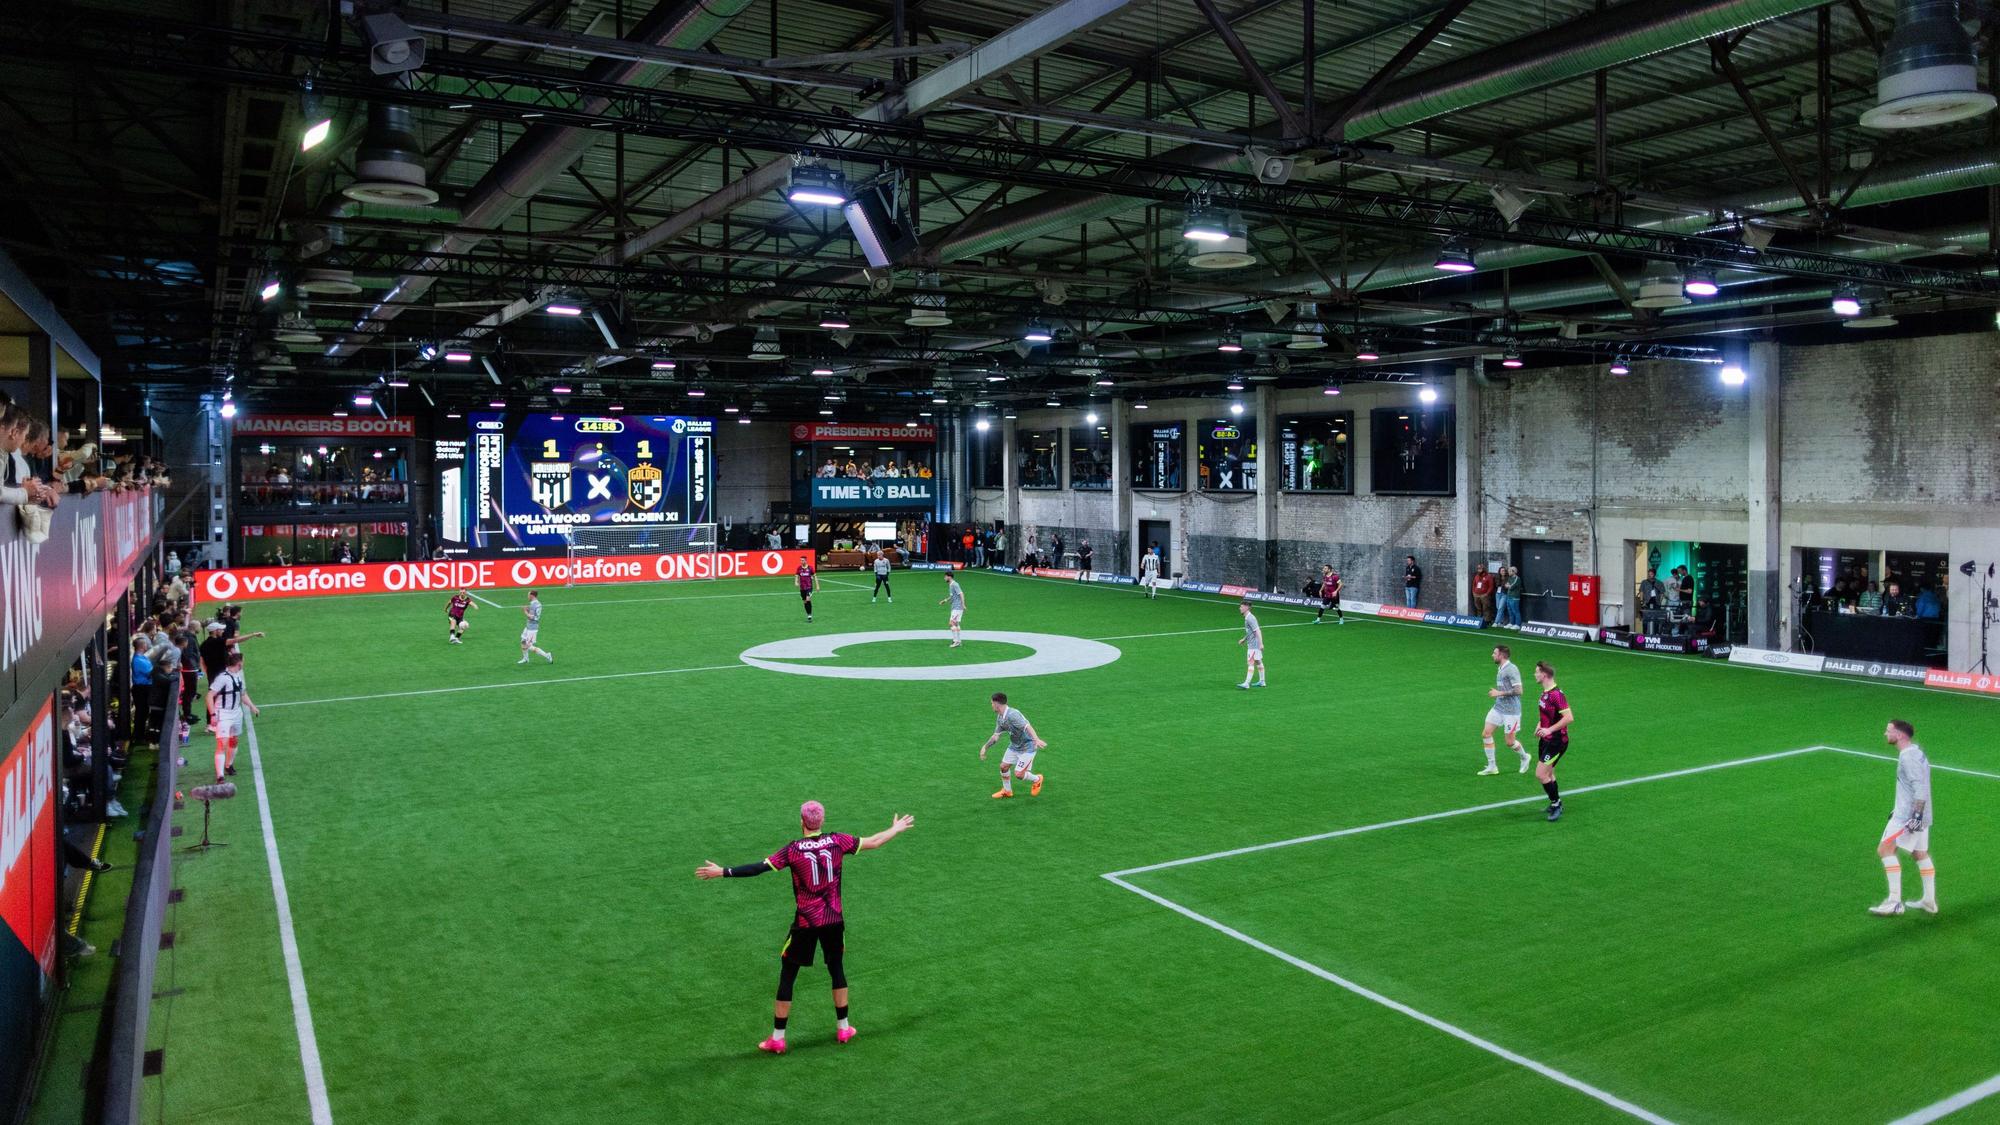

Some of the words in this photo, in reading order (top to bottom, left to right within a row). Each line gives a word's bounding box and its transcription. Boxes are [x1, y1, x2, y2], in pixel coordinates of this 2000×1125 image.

[237, 421, 343, 432] MANAGERS
[347, 420, 411, 432] BOOTH
[815, 426, 891, 437] PRESIDENTS
[892, 427, 933, 438] BOOTH
[435, 446, 460, 454] Galaxy
[543, 439, 560, 459] 1
[637, 440, 653, 459] 1
[480, 435, 490, 519] MOTORWORLD
[631, 469, 659, 480] GOLDEN
[632, 482, 643, 494] XI
[818, 485, 860, 499] TIME
[887, 485, 931, 499] BALL
[509, 513, 591, 525] HOLLYWOOD
[611, 512, 664, 522] GOLDEN
[665, 512, 678, 521] XI
[526, 524, 573, 535] UNITED
[540, 559, 641, 579] vodafone
[656, 553, 748, 579] ONSIDE
[243, 569, 366, 593] vodafone
[383, 561, 495, 590] ONSIDE
[1, 538, 42, 672] XING
[1424, 614, 1446, 622] BALLER
[1456, 618, 1480, 626] LEAGUE
[1520, 625, 1546, 634] BALLER
[1557, 631, 1584, 640] LEAGUE
[1606, 632, 1616, 640] TVN
[1644, 636, 1661, 644] TVN
[1824, 661, 1864, 673] BALLER
[1884, 667, 1926, 679] LEAGUE
[1928, 674, 1971, 686] BALLER
[0, 712, 53, 893] ALLER
[803, 848, 833, 886] 11
